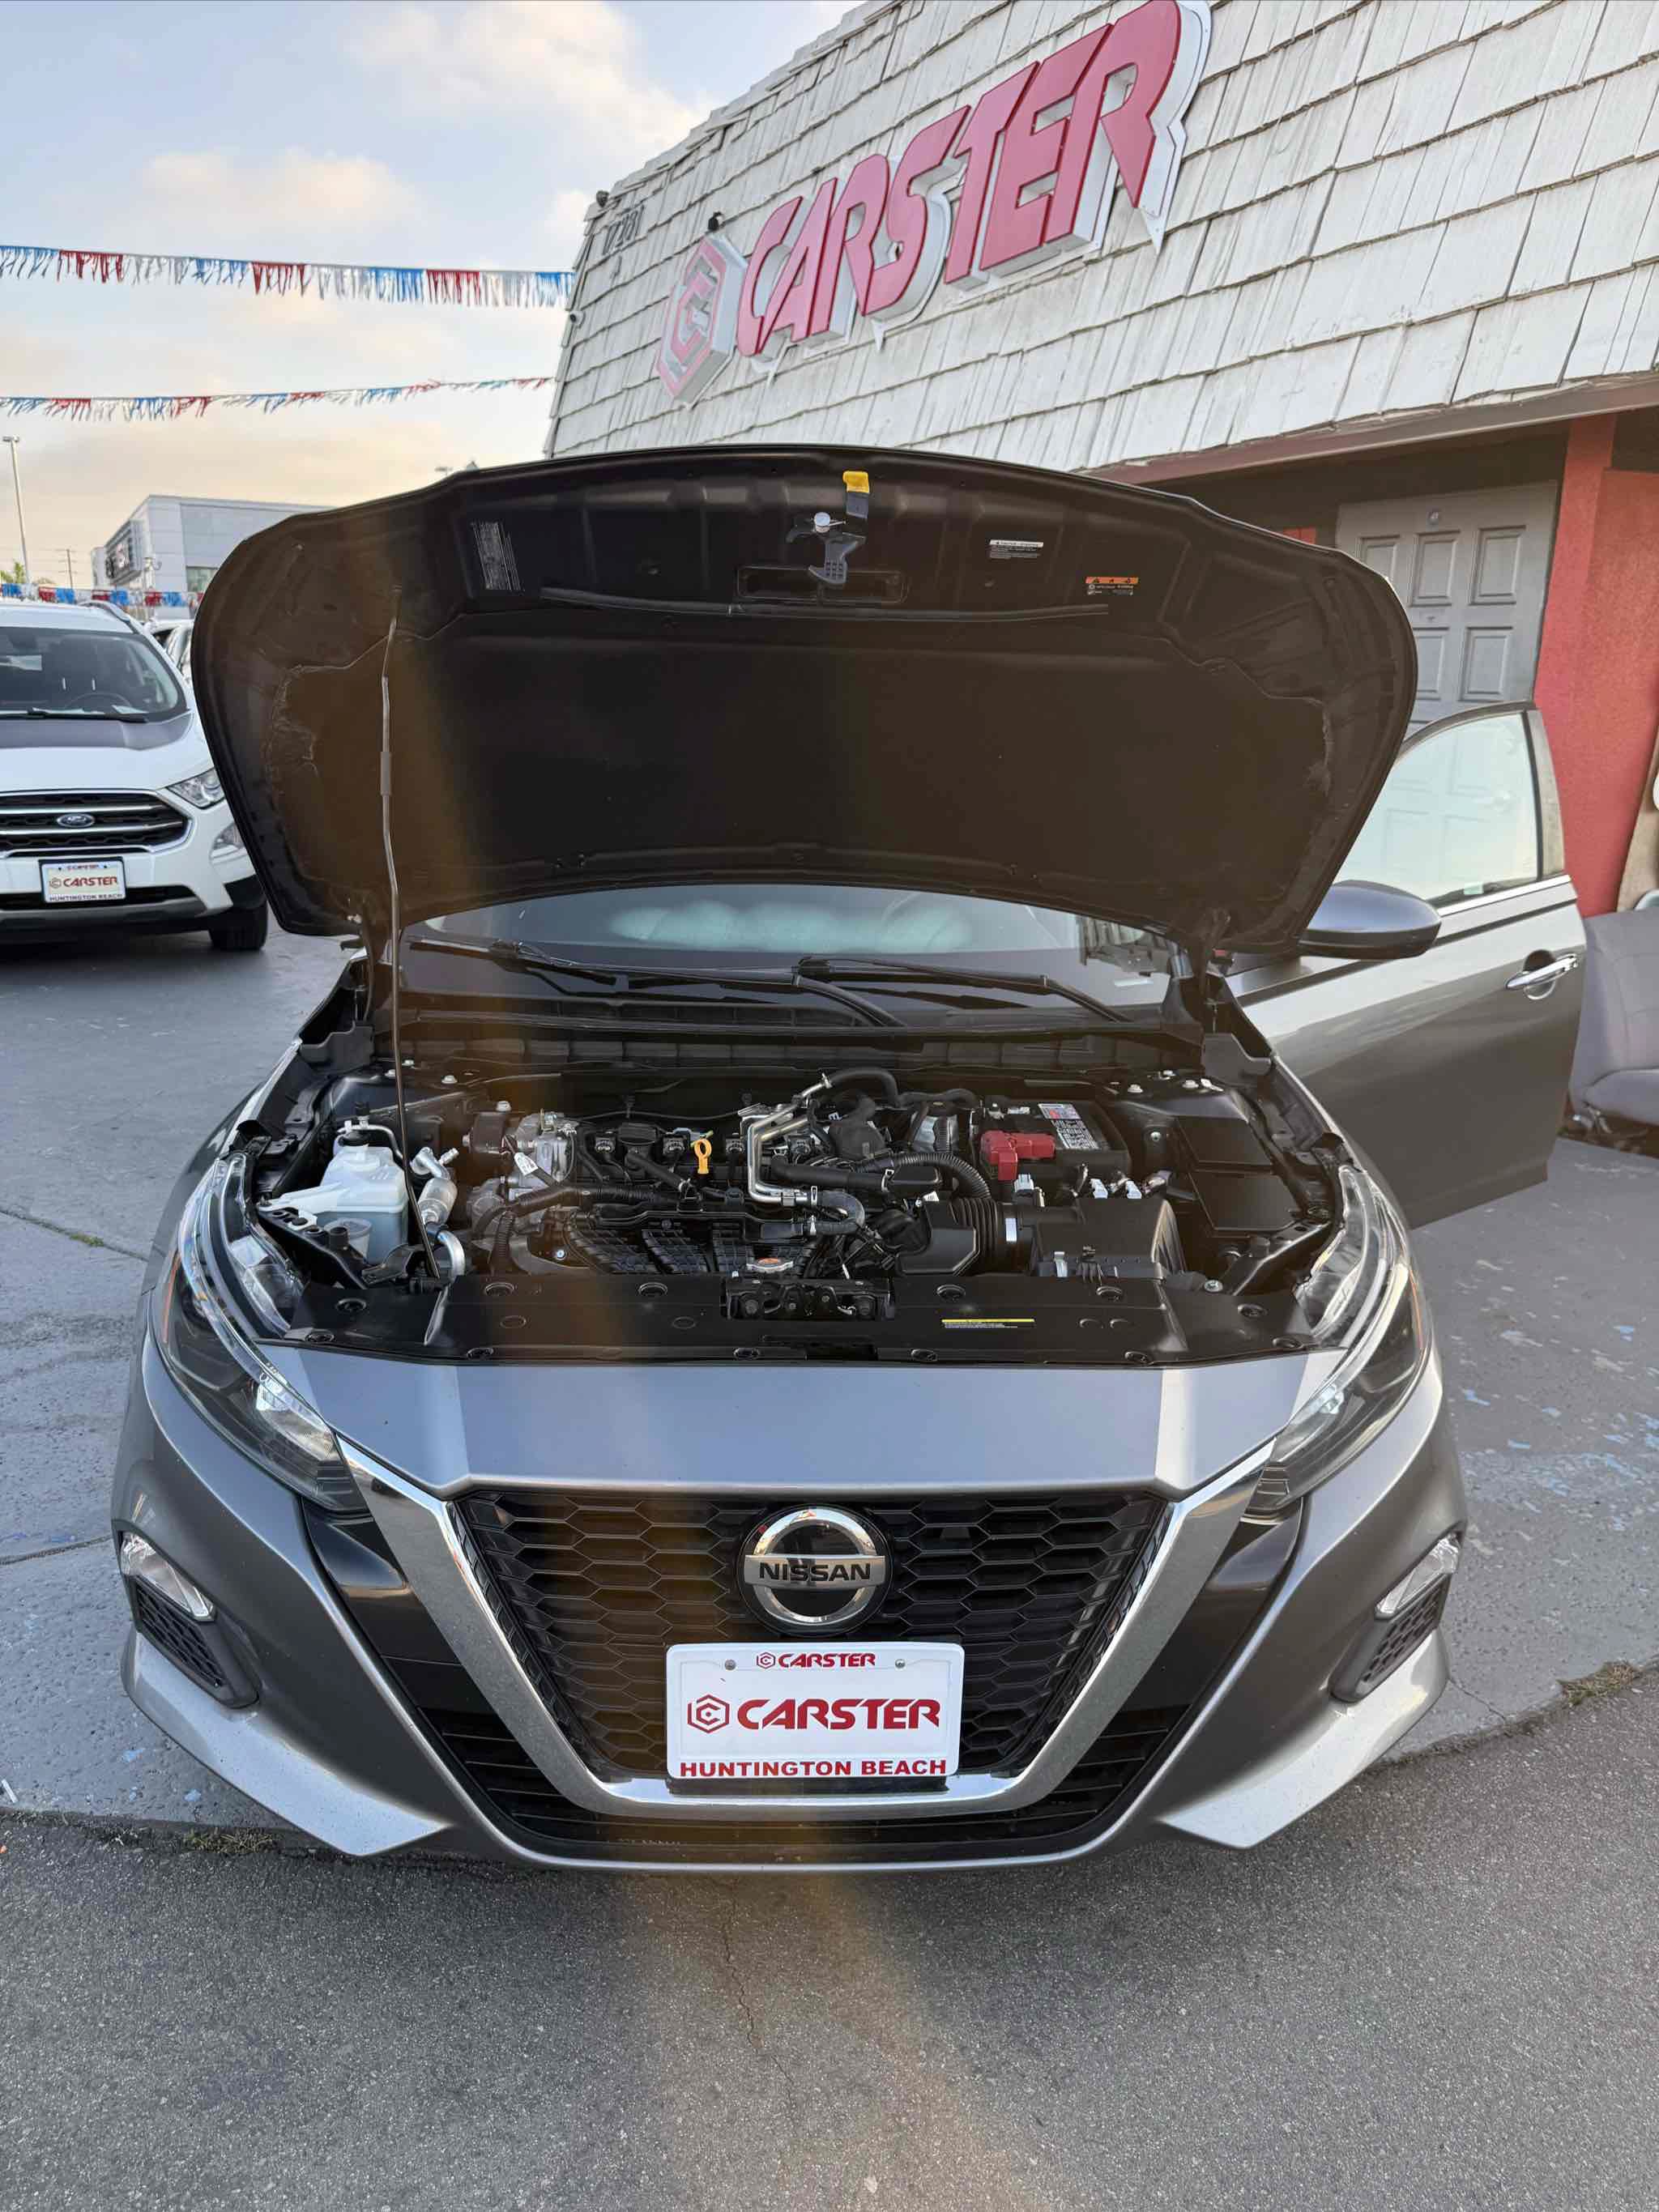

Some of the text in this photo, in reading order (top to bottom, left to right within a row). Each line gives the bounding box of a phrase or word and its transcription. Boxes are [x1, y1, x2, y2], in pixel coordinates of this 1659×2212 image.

[736, 0, 1183, 357] CARSTER
[63, 876, 118, 888] CARSTER
[759, 1562, 871, 1582] NISSAN
[778, 1652, 876, 1669] CARSTER
[737, 1698, 941, 1730] CARSTER
[680, 1759, 947, 1777] HUNTINGTON BEACH
